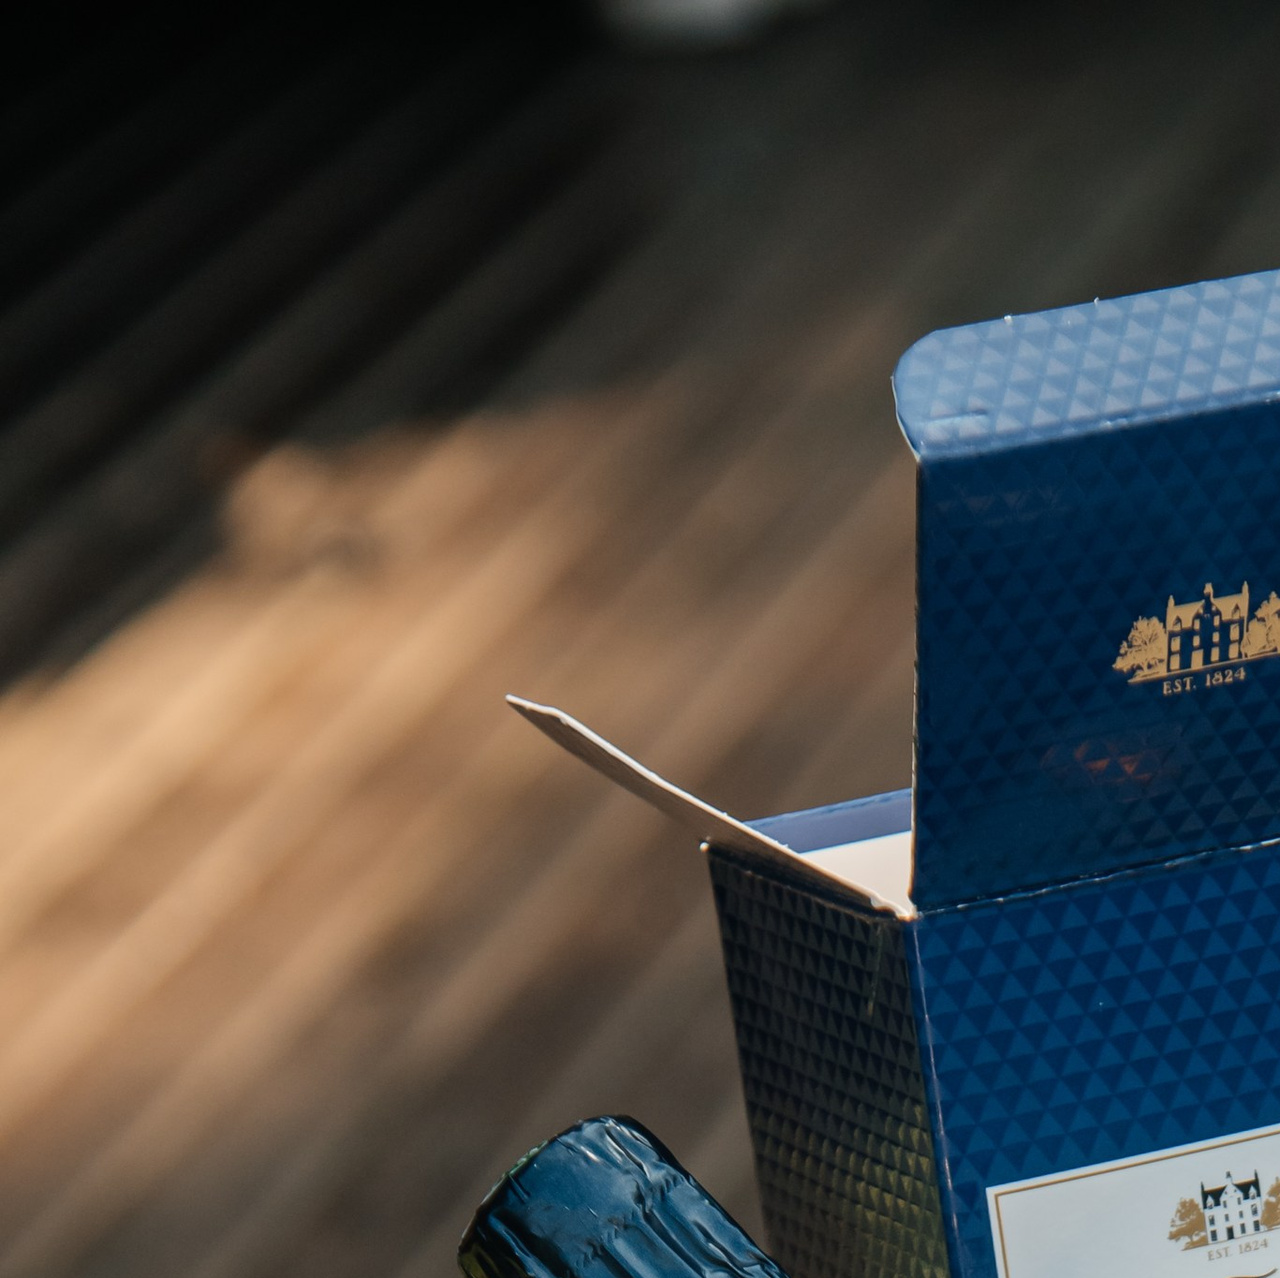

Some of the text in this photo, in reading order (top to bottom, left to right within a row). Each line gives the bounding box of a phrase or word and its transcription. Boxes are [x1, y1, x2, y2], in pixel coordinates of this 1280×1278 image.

[1163, 667, 1247, 695] EST. 1824
[1238, 1238, 1268, 1254] 1824
